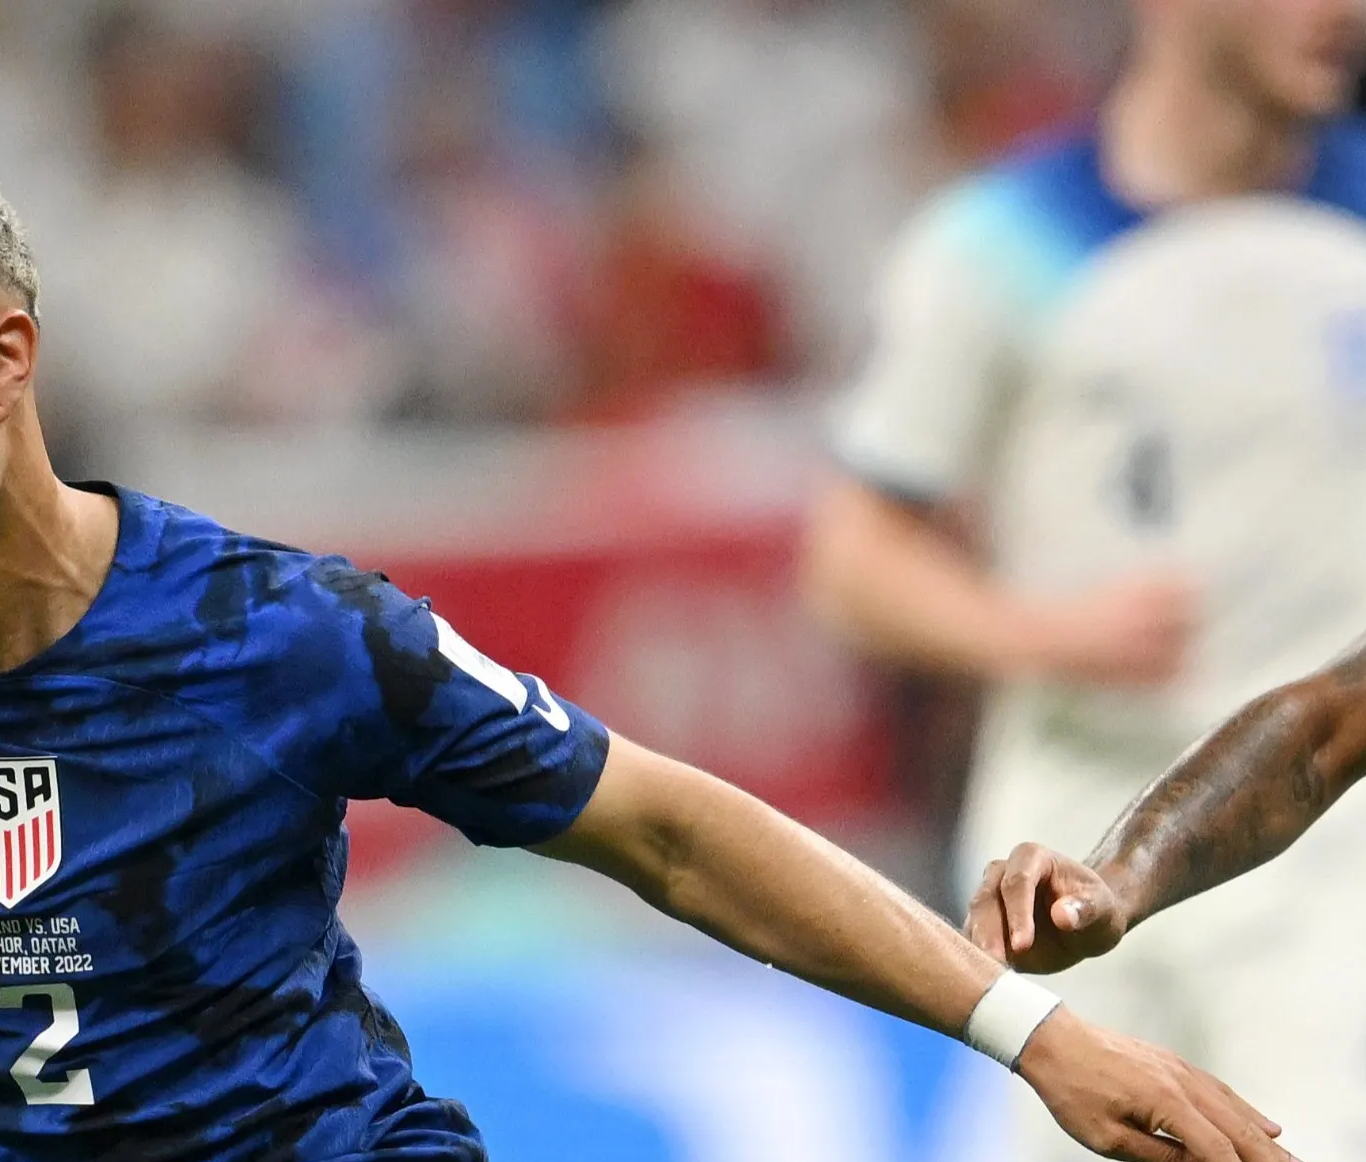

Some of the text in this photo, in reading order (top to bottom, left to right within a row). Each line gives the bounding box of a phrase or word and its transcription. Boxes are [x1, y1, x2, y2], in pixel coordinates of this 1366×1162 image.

[25, 918, 47, 935] VS.
[50, 917, 80, 934] USA
[54, 954, 93, 973] 2022
[0, 983, 95, 1105] 2
